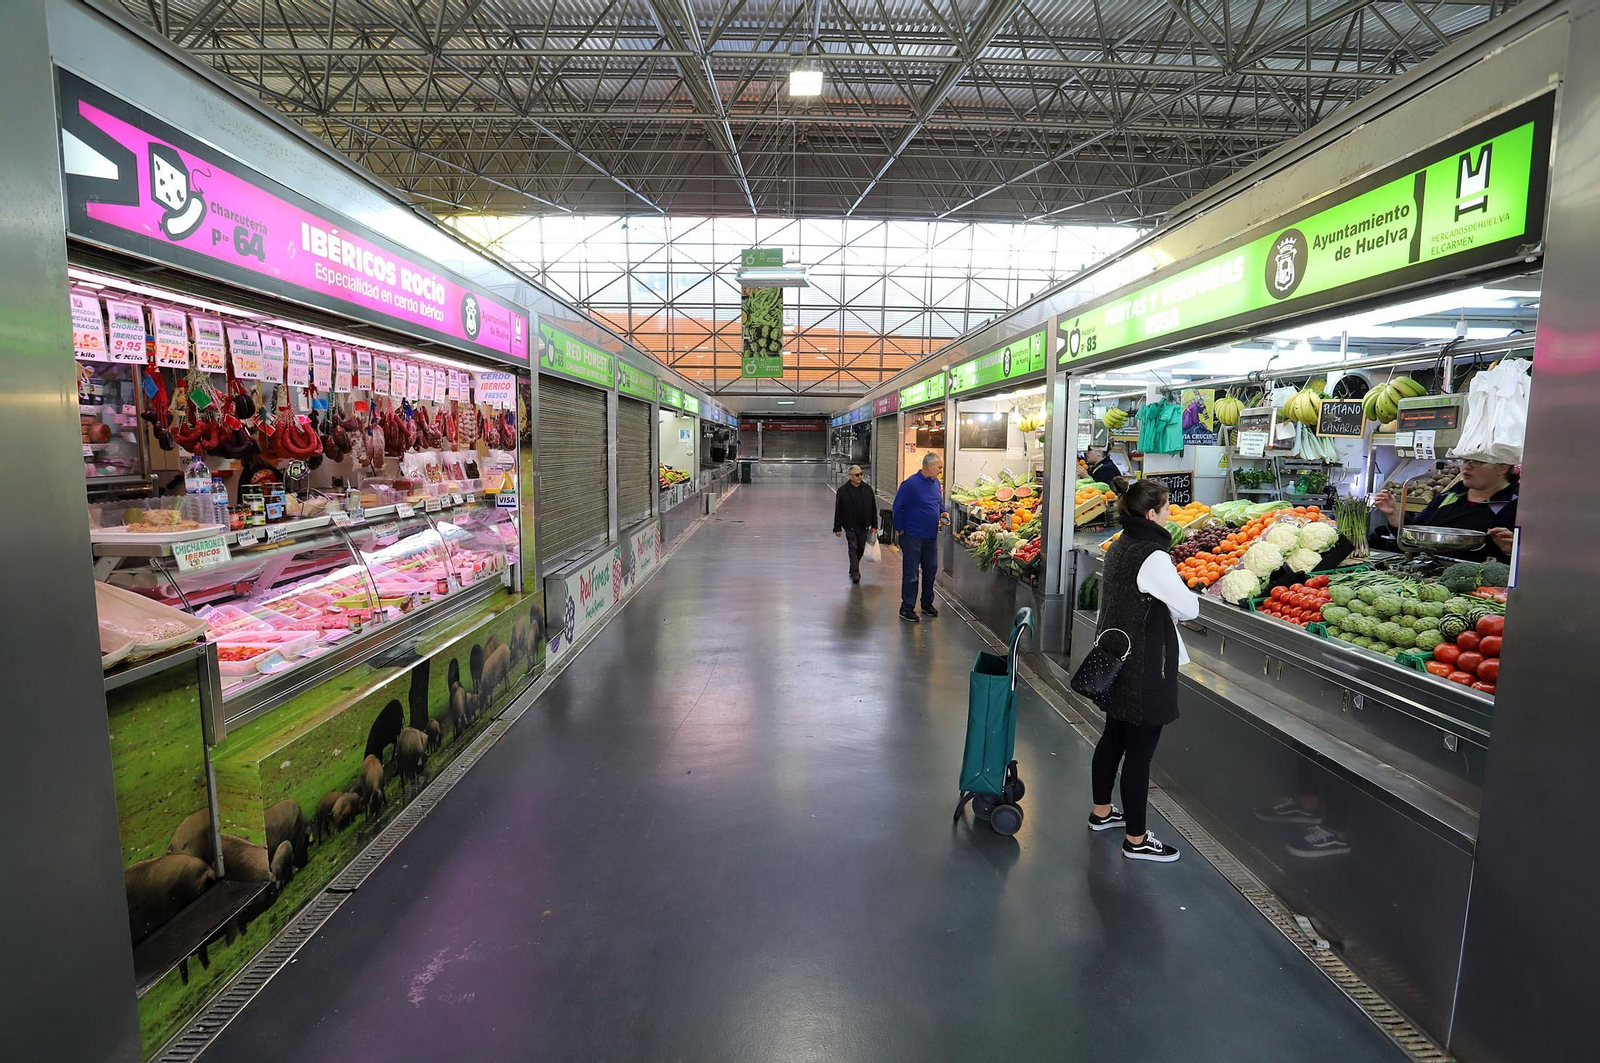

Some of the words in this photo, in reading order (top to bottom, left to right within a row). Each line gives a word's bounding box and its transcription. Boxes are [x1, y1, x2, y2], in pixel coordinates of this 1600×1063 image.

[1312, 203, 1410, 250] Ayuntamiento
[234, 225, 266, 262] 64
[1334, 246, 1351, 262] de
[1356, 227, 1408, 255] Huelva
[301, 222, 396, 286] IBÉRICOS
[400, 265, 446, 306] ROCÍO
[314, 262, 379, 300] Especialidad
[381, 289, 392, 304] en
[394, 293, 418, 313] cerdo
[71, 308, 96, 316] ORIZOS
[73, 315, 100, 324] ECIALES
[73, 323, 99, 331] RBACOA
[111, 322, 144, 332] CHORIZO
[112, 332, 143, 340] IBERICO
[114, 340, 142, 352] 8,95
[1086, 335, 1097, 352] 83
[566, 340, 581, 361] RED
[584, 348, 607, 372] FOREST
[480, 382, 511, 390] IBERICO
[1322, 403, 1361, 416] PLÁTANO
[1322, 421, 1361, 434] CANARIAS
[1169, 490, 1190, 503] ENAS
[175, 538, 225, 555] CHICHARRONES
[185, 548, 220, 560] IBERICOS
